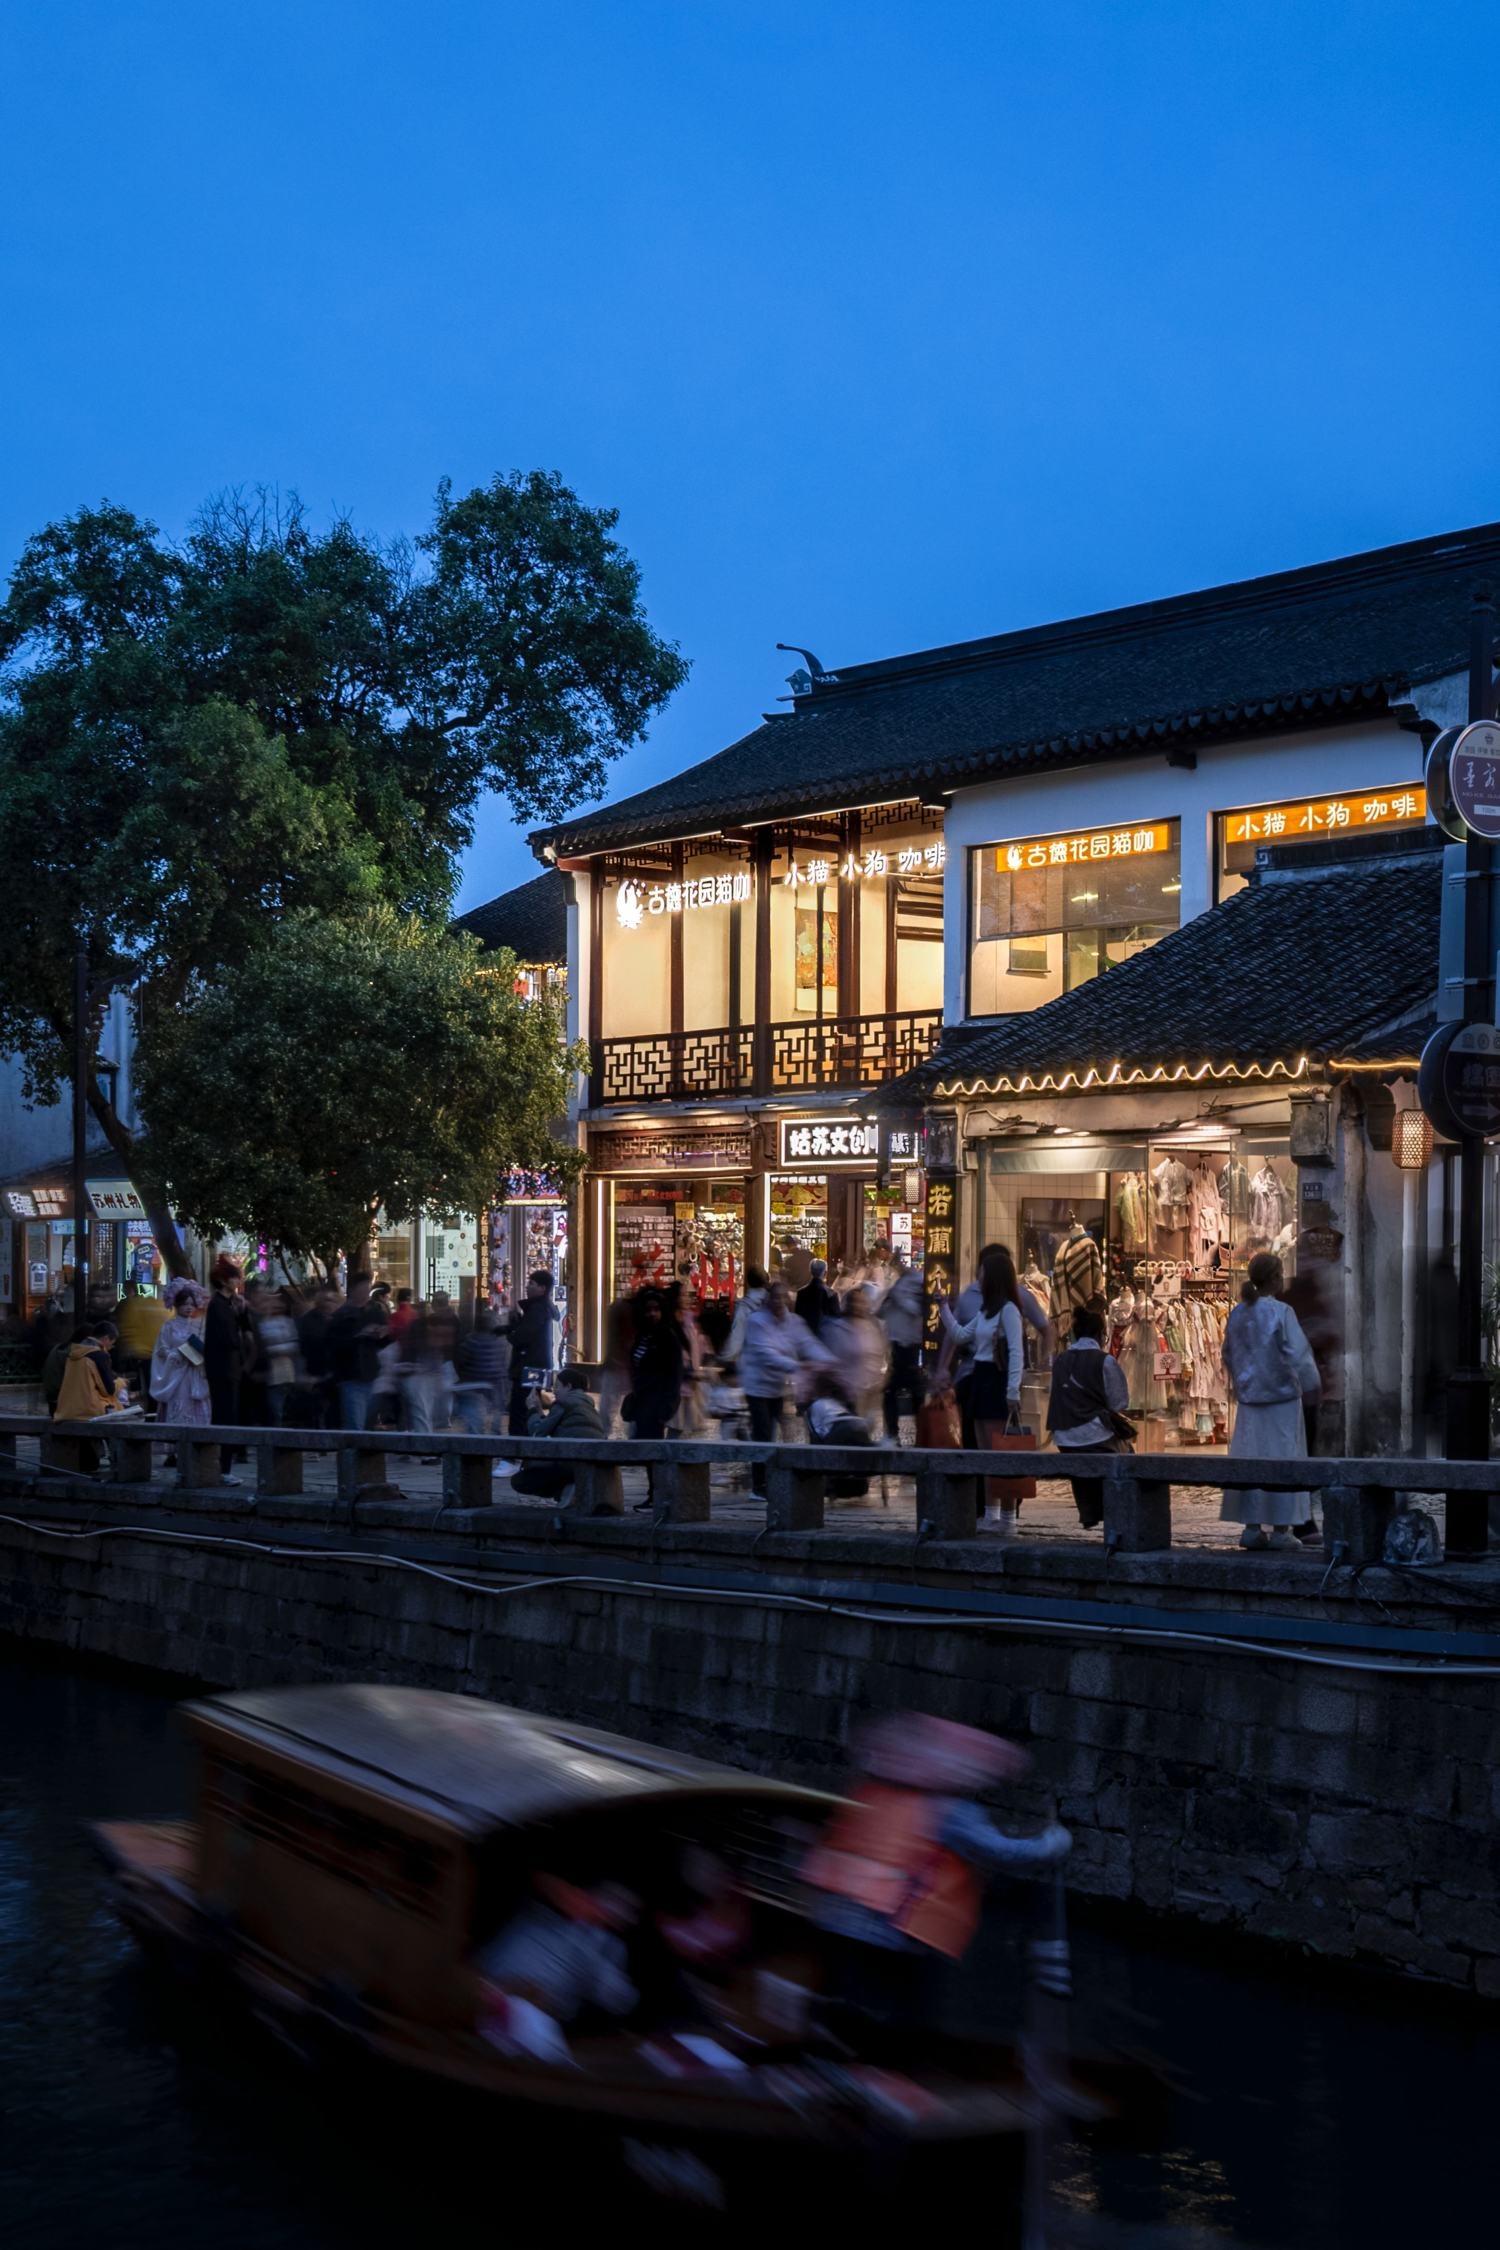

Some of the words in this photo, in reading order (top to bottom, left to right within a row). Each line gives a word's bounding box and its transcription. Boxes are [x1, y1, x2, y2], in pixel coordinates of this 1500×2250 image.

[1237, 812, 1286, 839] 小猫
[1300, 802, 1350, 831] 小狗
[1363, 793, 1417, 822] 咖啡
[785, 859, 829, 888] 小猫
[840, 849, 888, 880] 小狗
[898, 842, 945, 872] 咖啡
[91, 1193, 141, 1208] 苏州礼物
